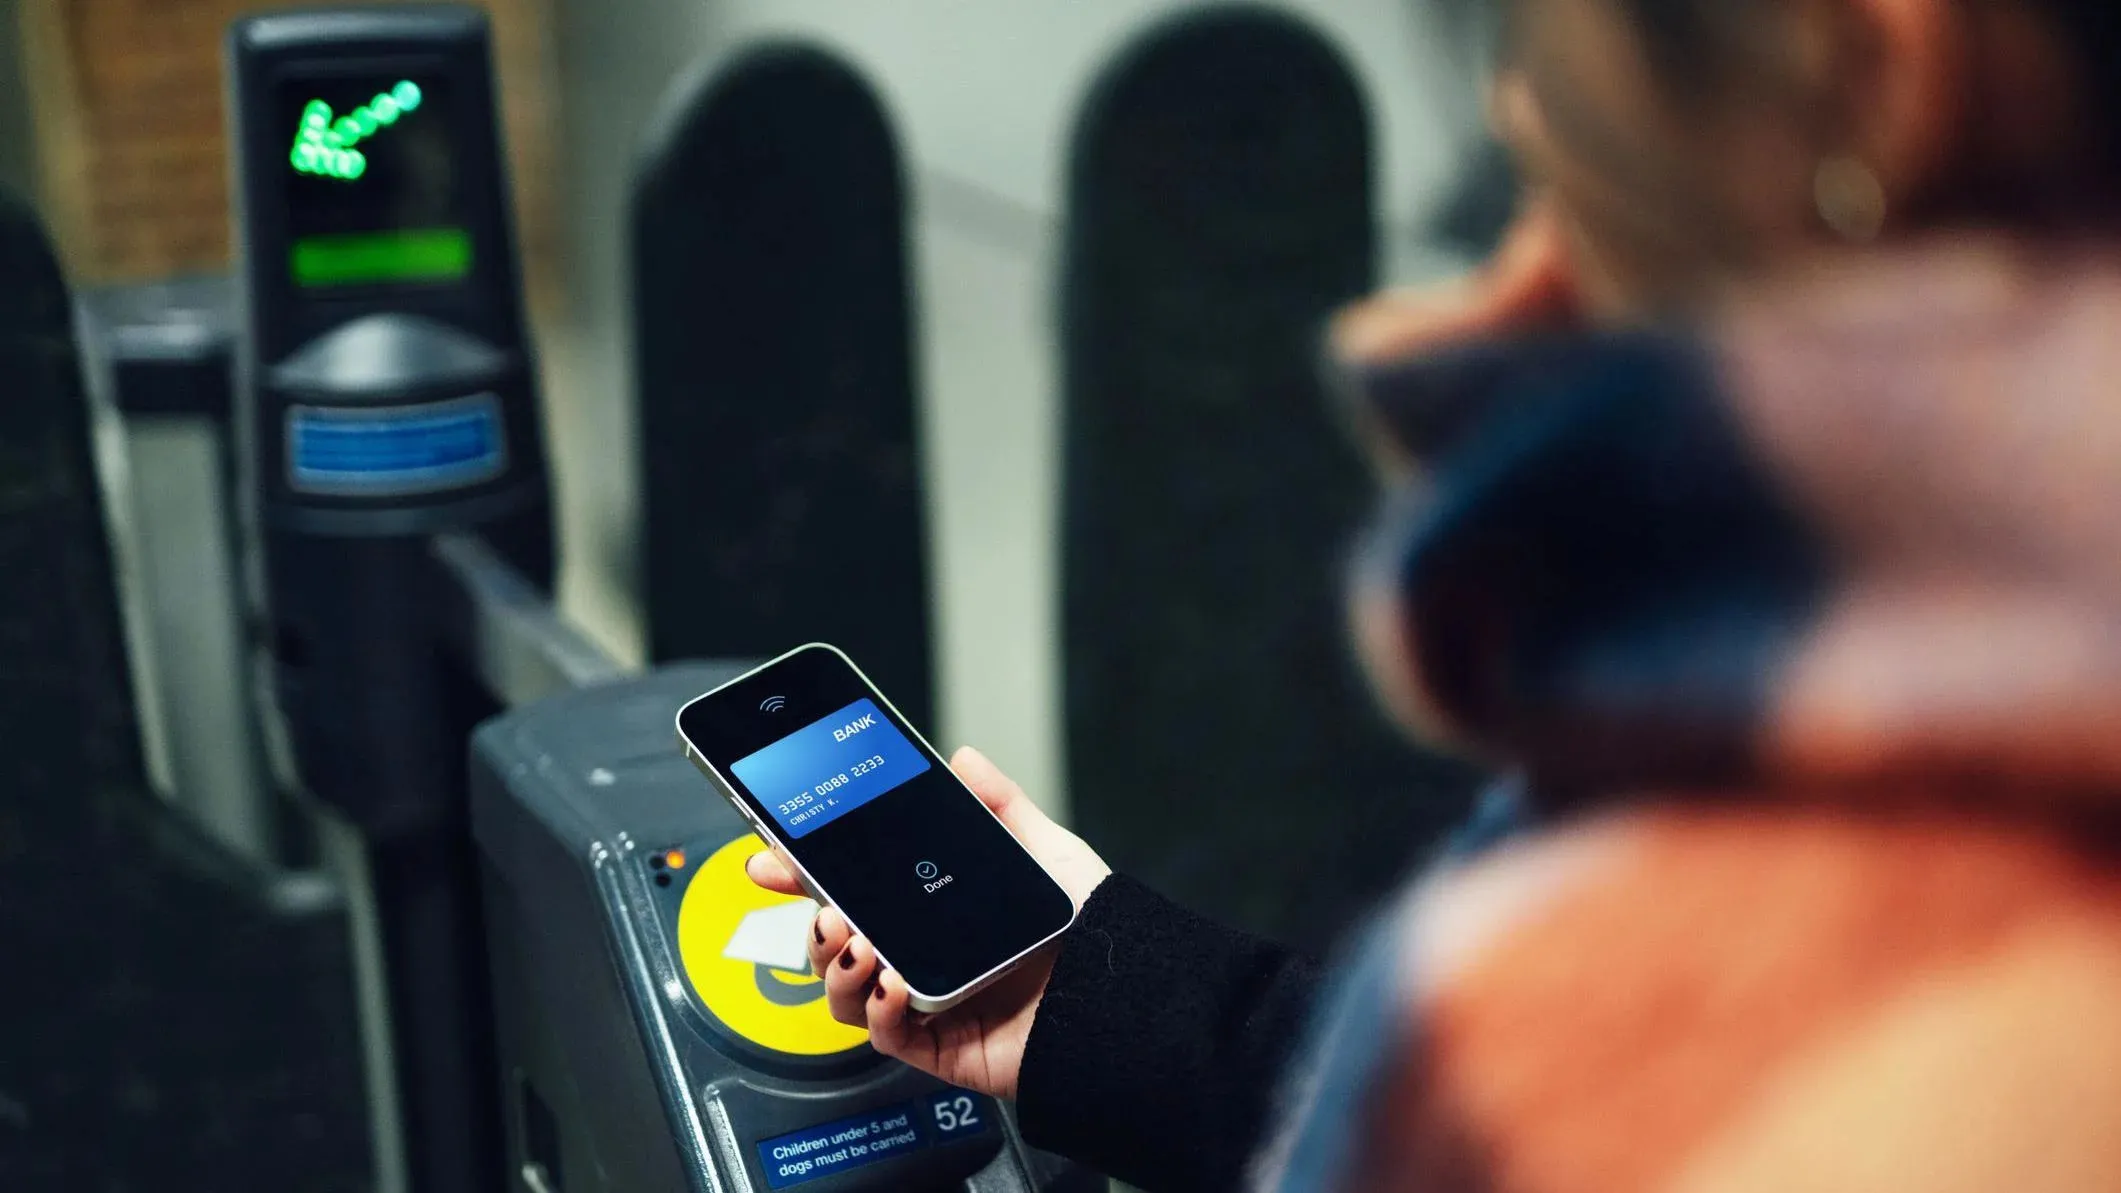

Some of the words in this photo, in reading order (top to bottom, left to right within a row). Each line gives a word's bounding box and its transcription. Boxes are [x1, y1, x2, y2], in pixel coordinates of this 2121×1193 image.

[832, 713, 877, 743] BANK
[778, 791, 814, 815] 3355
[815, 773, 849, 796] 0088
[850, 755, 885, 777] 2233
[789, 803, 825, 826] CHRISTY
[923, 873, 953, 894] Done
[934, 1096, 979, 1131] 52
[773, 1138, 829, 1160] Children
[830, 1126, 868, 1144] under
[870, 1121, 881, 1133] 5
[883, 1113, 908, 1131] and
[779, 1160, 813, 1177] dogs
[815, 1148, 849, 1167] must
[849, 1144, 868, 1157] be
[870, 1129, 916, 1152] carried
